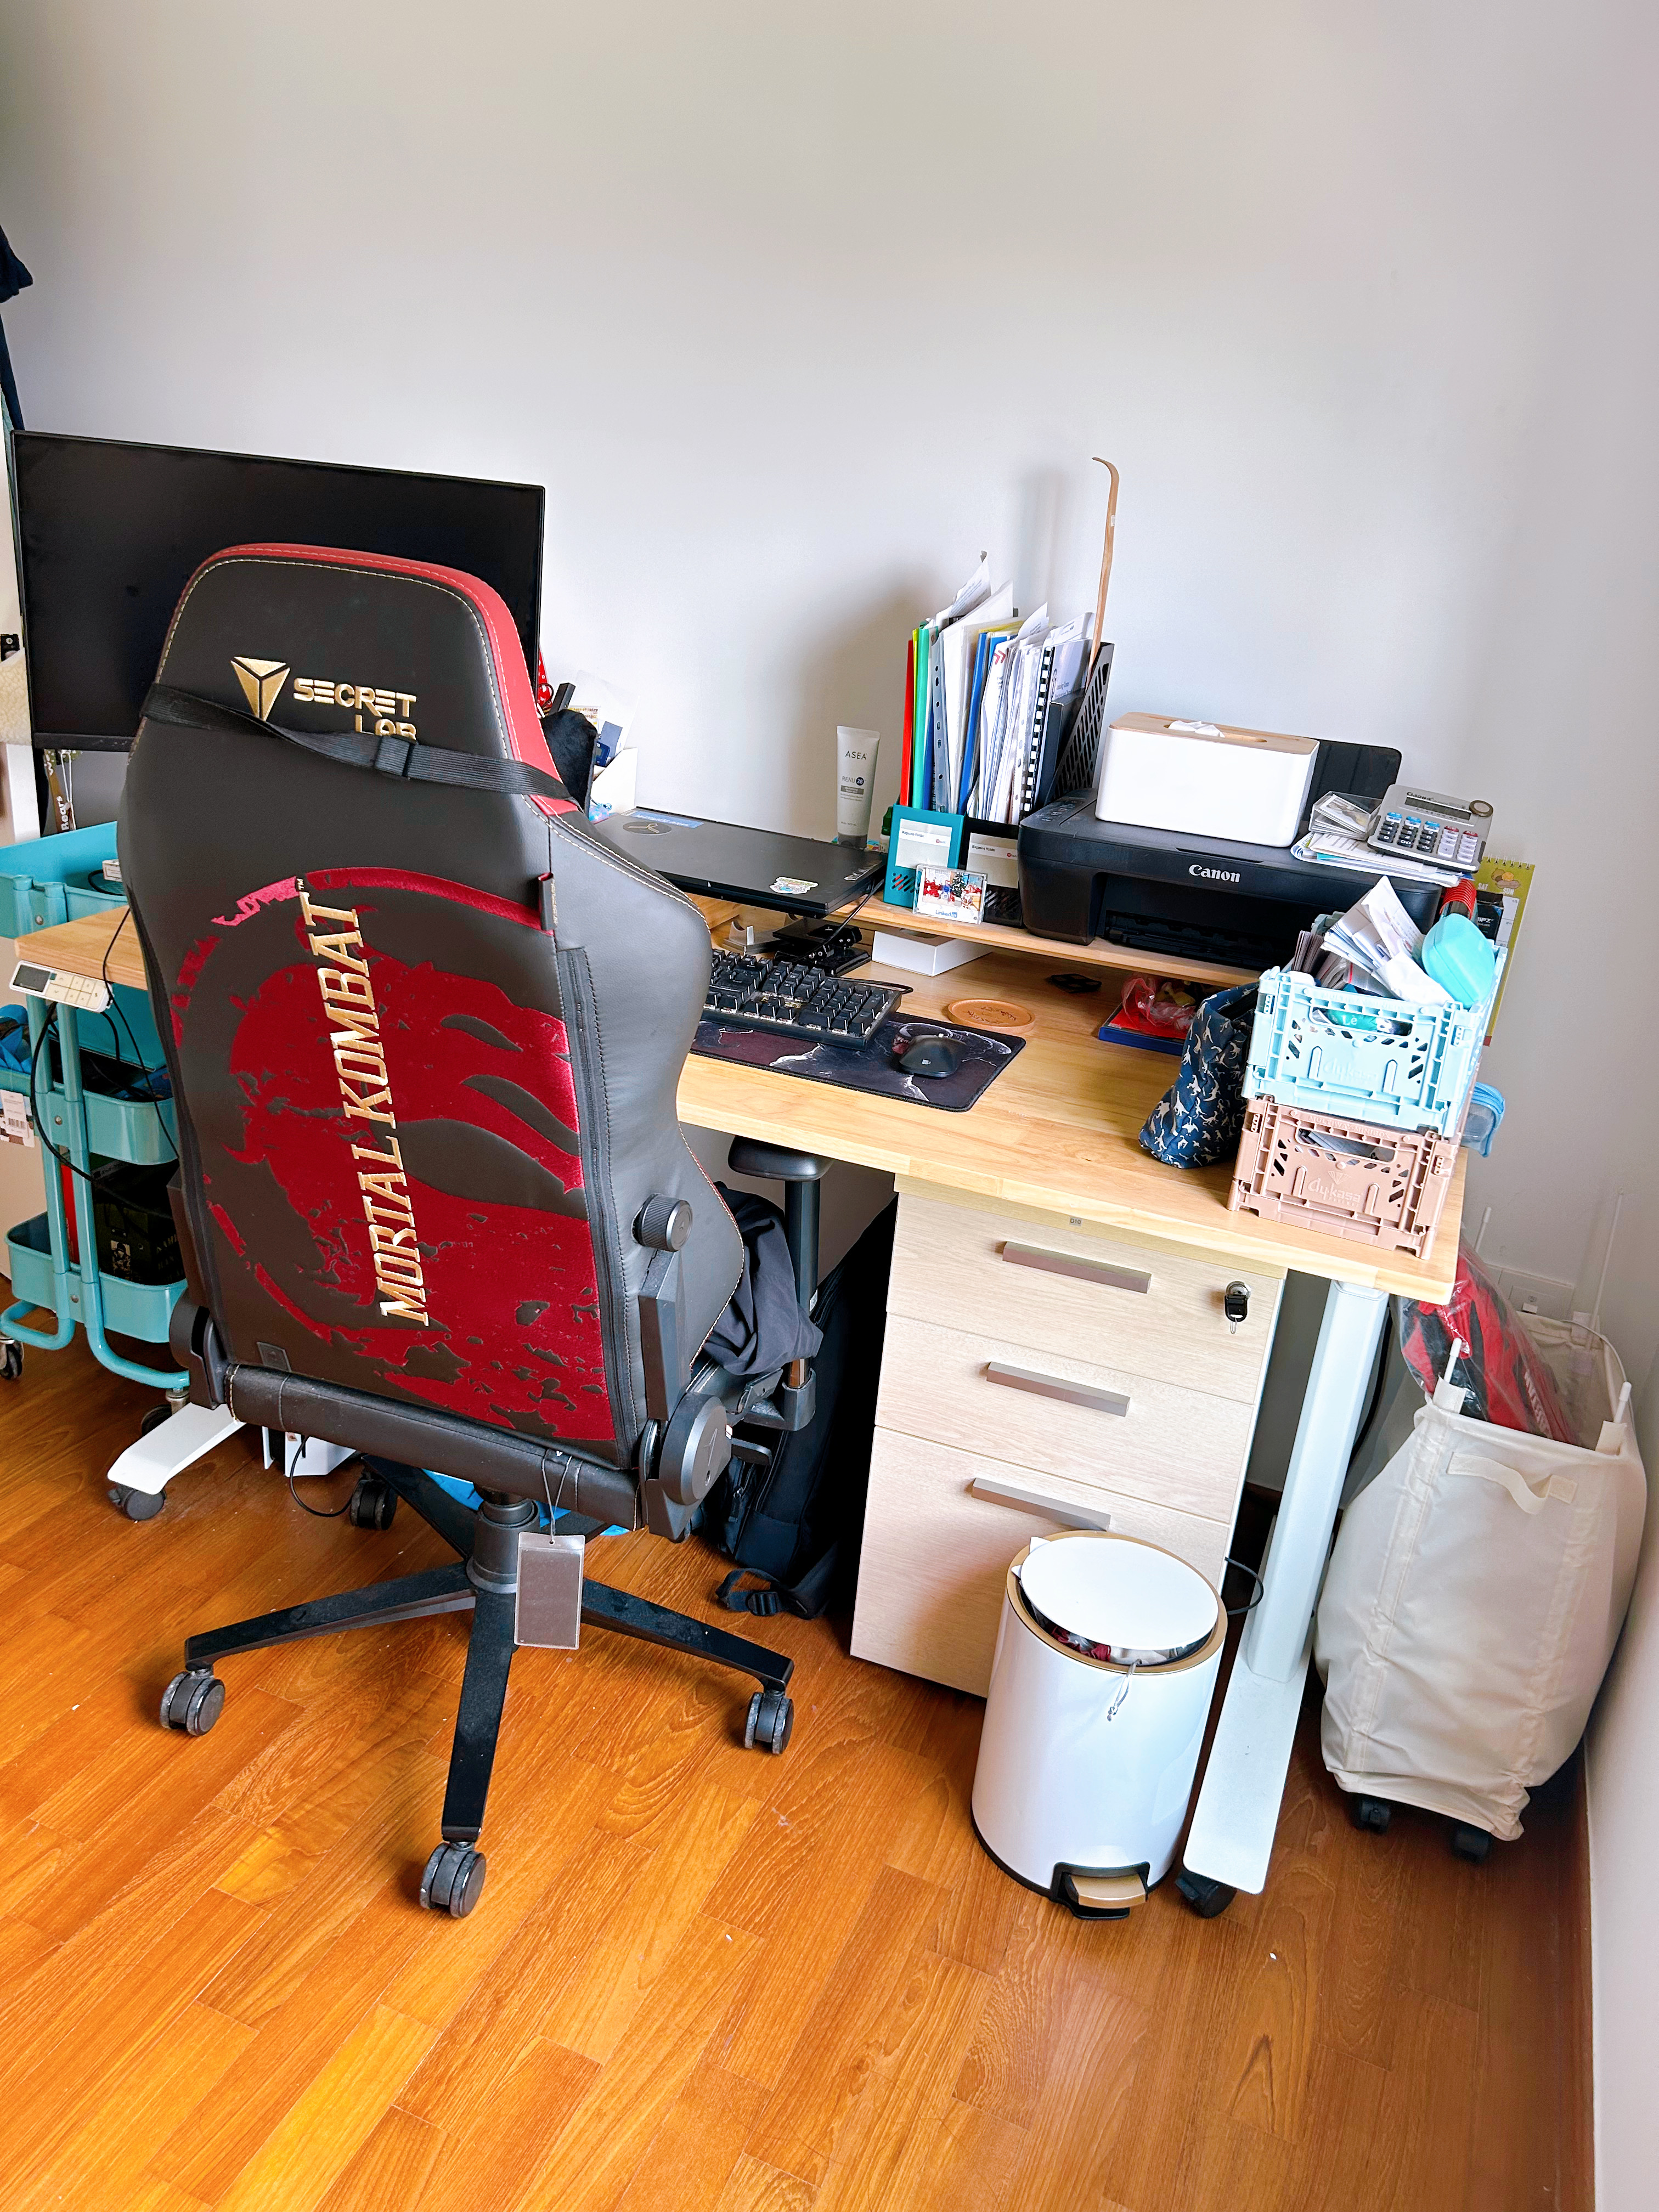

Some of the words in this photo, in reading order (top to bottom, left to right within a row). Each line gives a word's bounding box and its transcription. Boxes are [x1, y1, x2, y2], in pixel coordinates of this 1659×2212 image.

[293, 678, 417, 718] SECRET
[845, 751, 867, 760] ASEA
[1189, 864, 1240, 883] Canon
[300, 891, 396, 1130] KOMBAT
[351, 1135, 429, 1327] MORTAL
